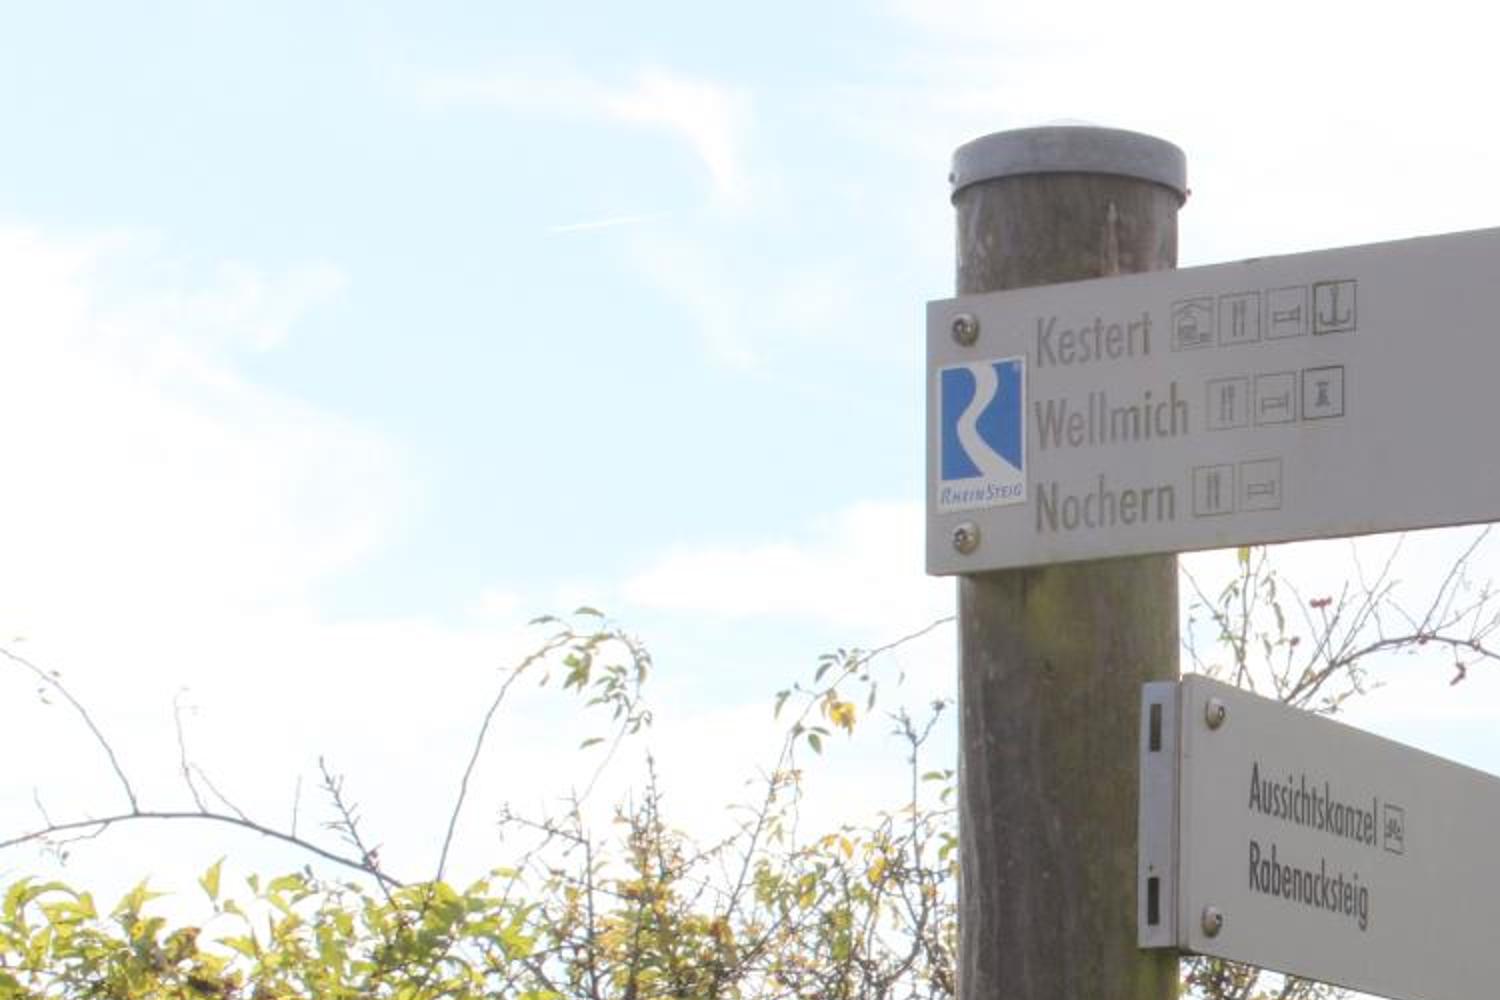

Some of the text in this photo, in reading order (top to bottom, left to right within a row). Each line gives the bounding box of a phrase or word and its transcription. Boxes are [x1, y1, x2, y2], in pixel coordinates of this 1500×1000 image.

[1036, 312, 1152, 367] Kestert
[1036, 381, 1188, 451] Wellmich
[1036, 475, 1175, 533] Nochern
[1249, 762, 1377, 847] Aussichtskanzel
[1249, 841, 1368, 930] Rabenacksteig
